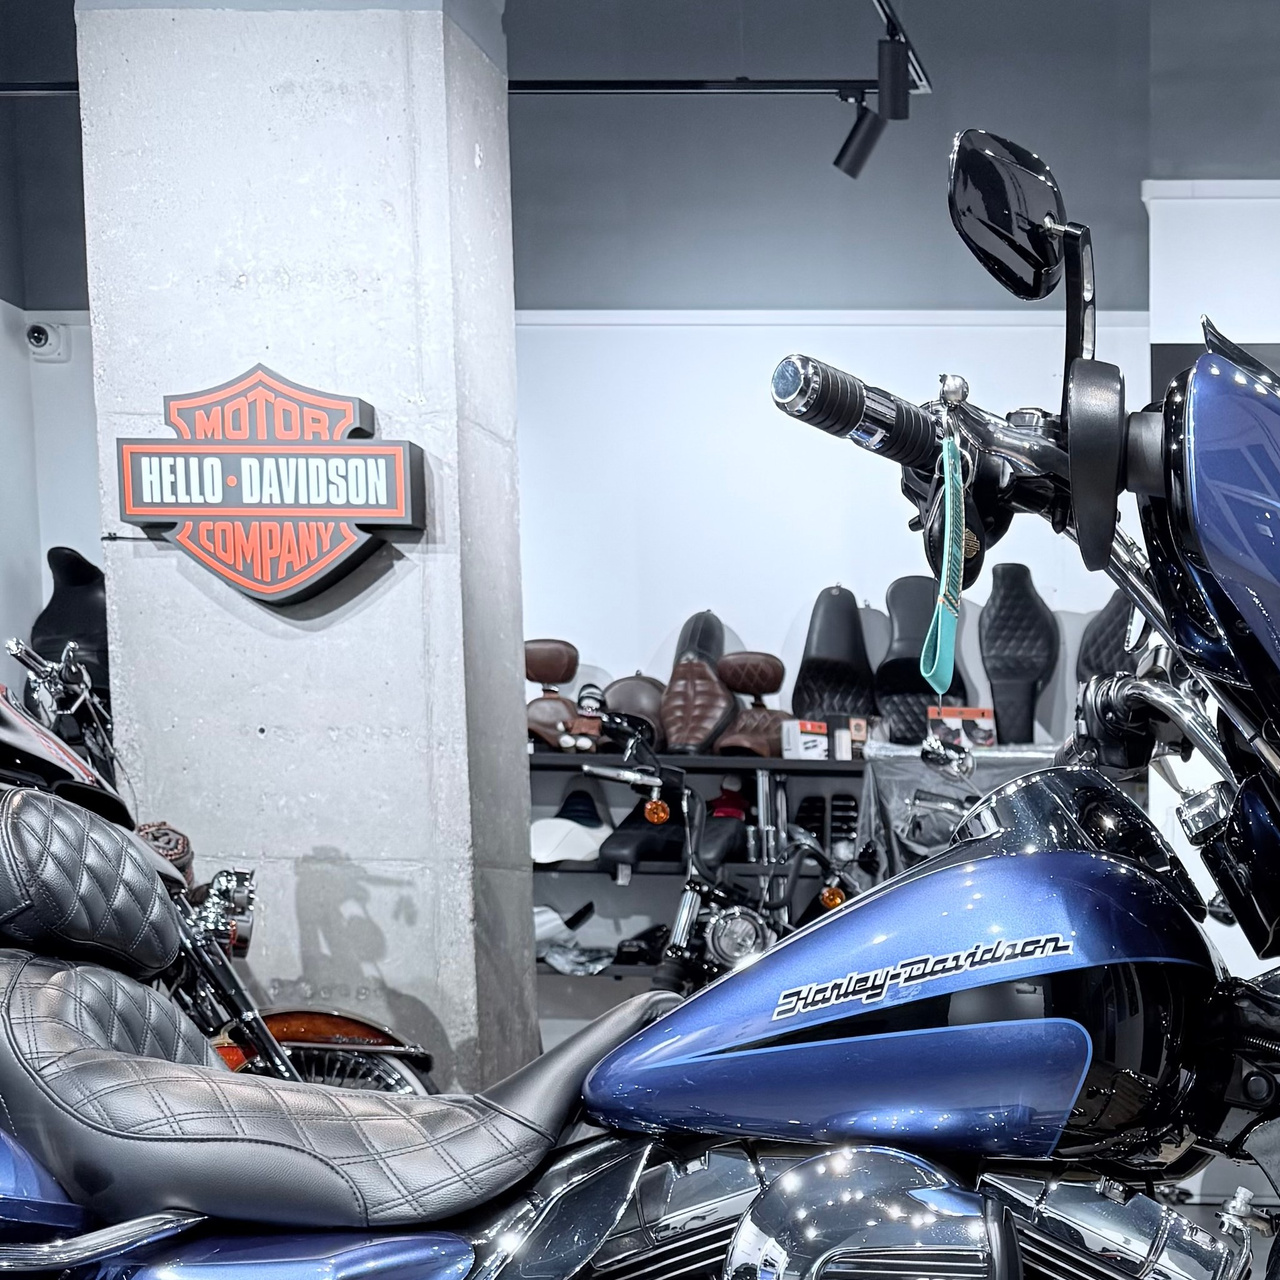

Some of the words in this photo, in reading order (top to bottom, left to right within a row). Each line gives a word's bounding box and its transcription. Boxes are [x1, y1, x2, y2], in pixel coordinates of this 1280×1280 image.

[195, 386, 329, 440] MOTOR
[141, 456, 223, 504] HELLO
[240, 457, 387, 505] DAVIDSON
[199, 521, 335, 582] COMPANY
[772, 934, 1073, 1020] Harley-Davidson
